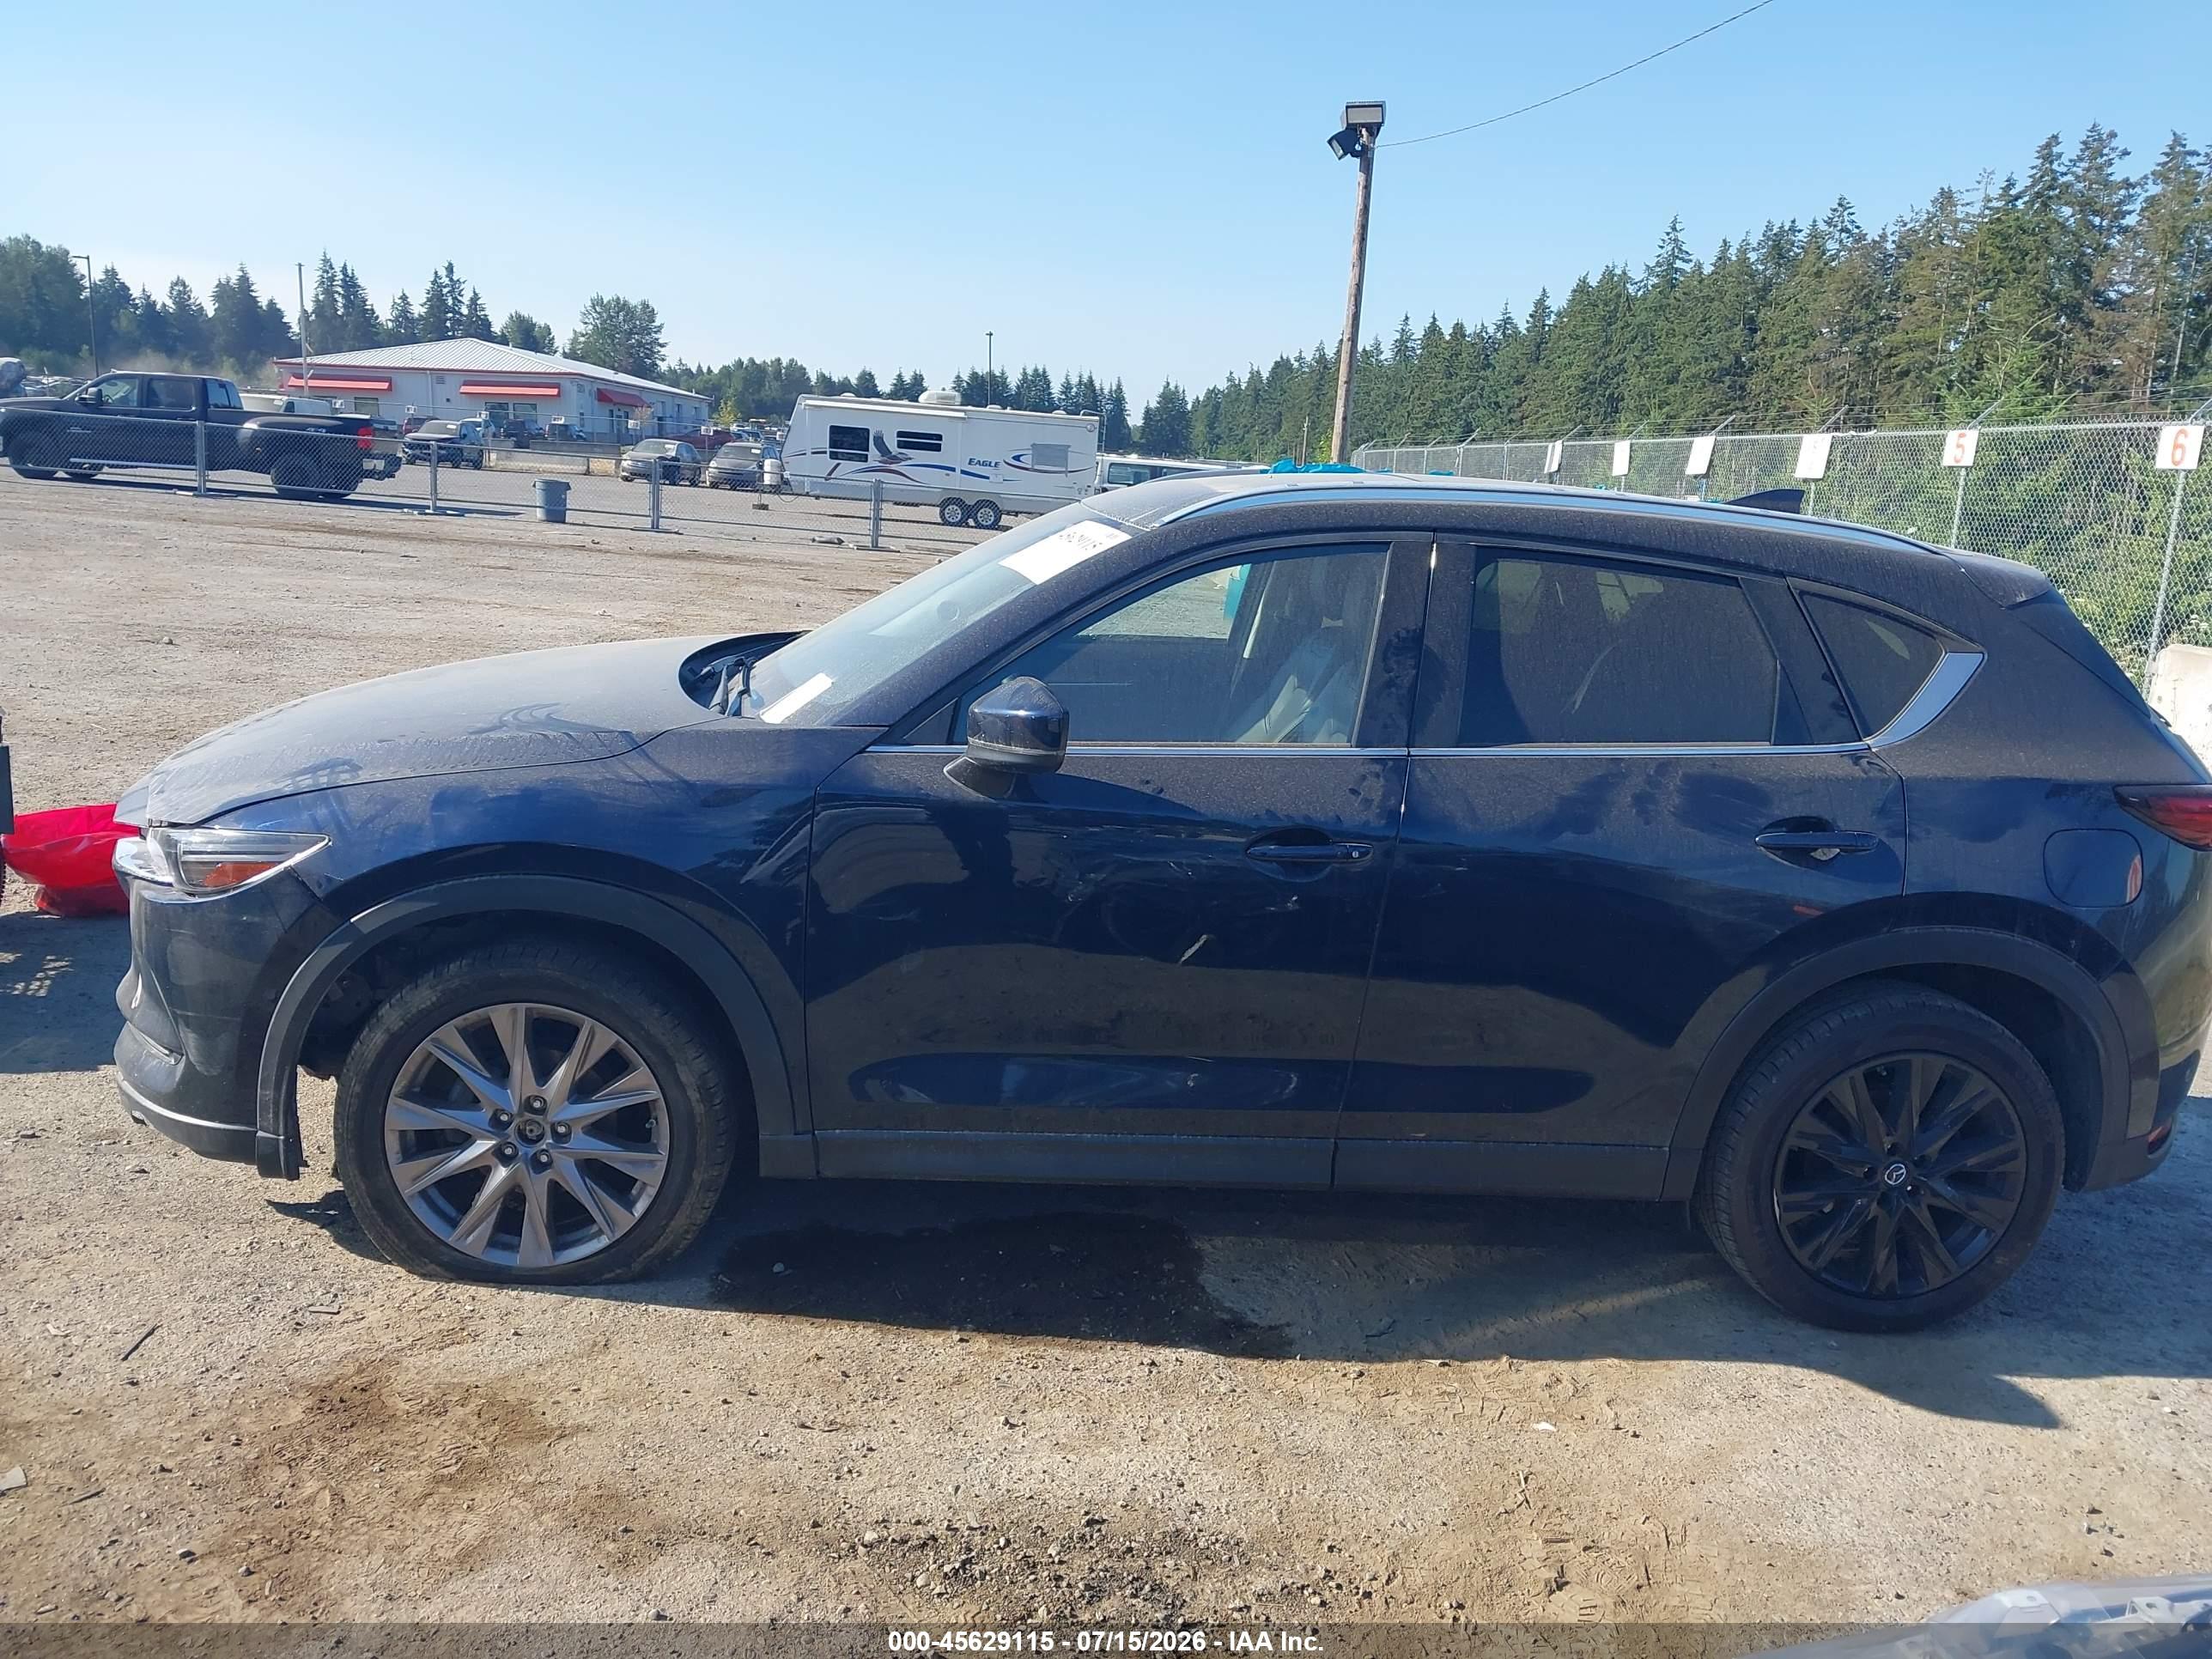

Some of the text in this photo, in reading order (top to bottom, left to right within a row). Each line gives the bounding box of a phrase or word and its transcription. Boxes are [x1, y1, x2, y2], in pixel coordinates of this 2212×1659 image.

[968, 458, 1001, 468] EAGLE
[1954, 432, 1966, 464] 5
[2171, 428, 2189, 466] 6
